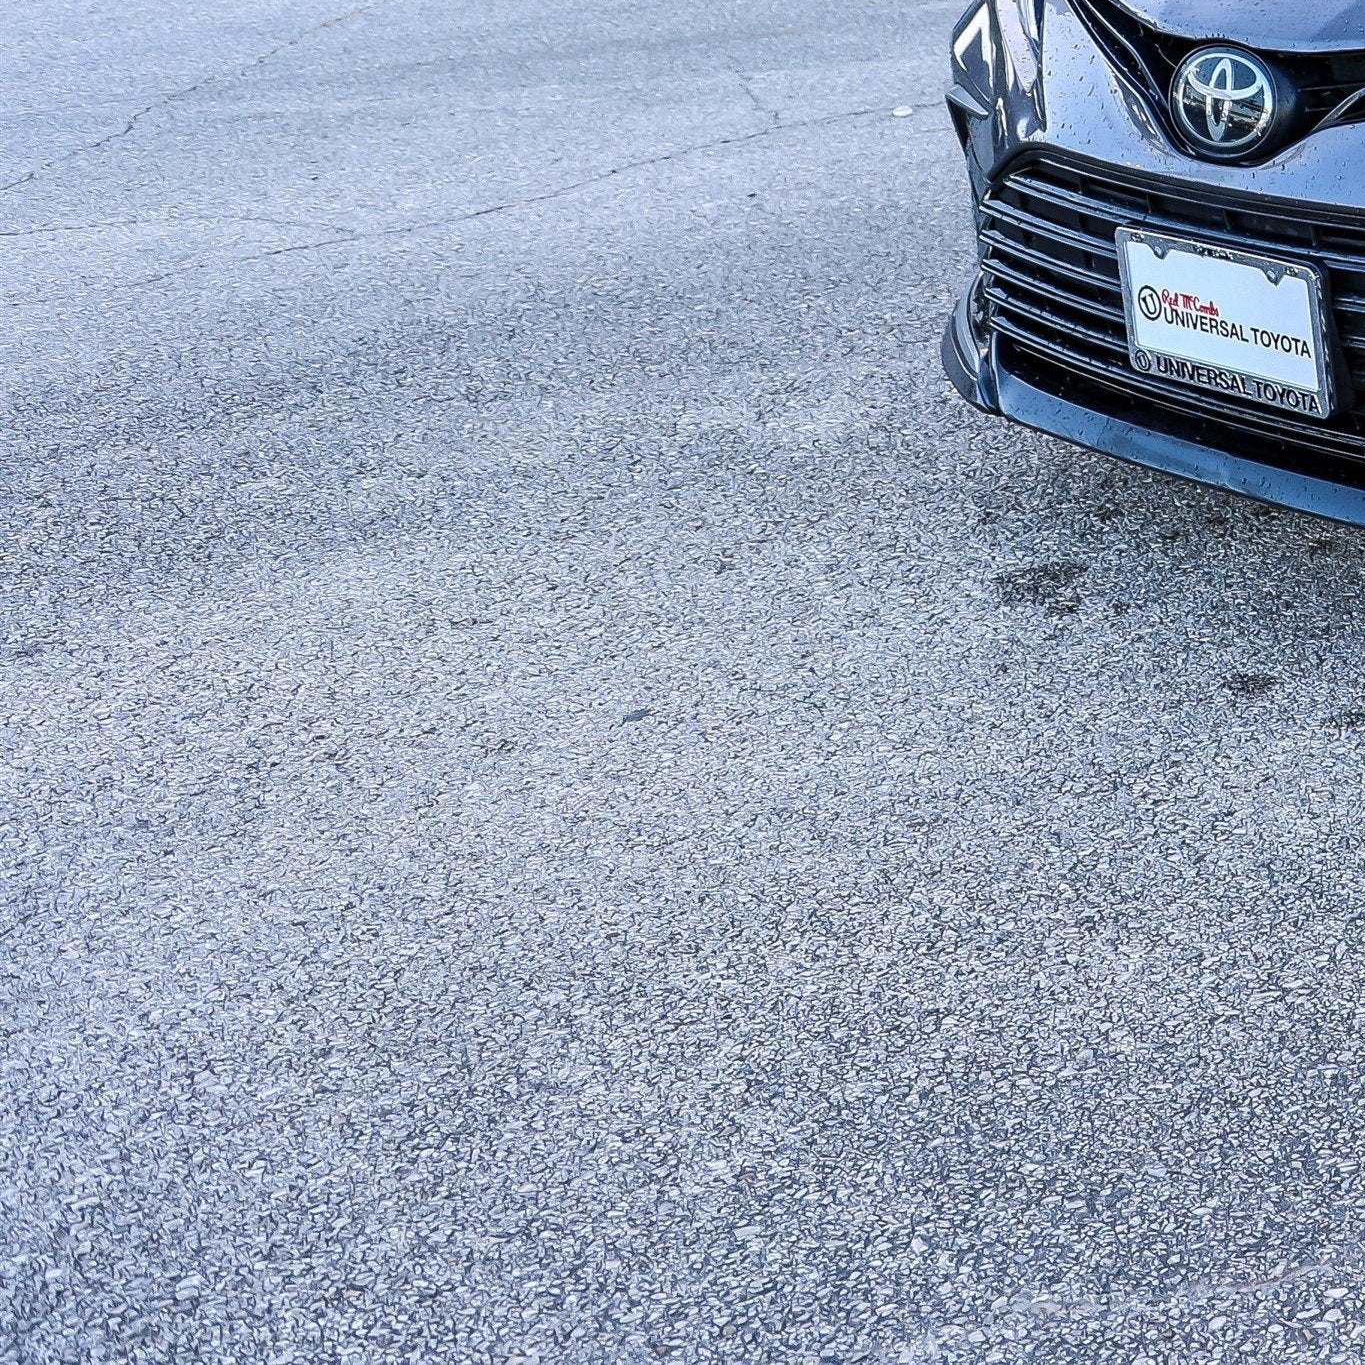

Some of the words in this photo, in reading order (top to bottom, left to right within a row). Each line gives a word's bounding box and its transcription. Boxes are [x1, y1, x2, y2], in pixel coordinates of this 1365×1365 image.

[1161, 288, 1180, 309] Red
[1163, 306, 1249, 343] UNIVERSAL
[1250, 326, 1312, 358] TOYOTA
[1156, 354, 1252, 396] UNIVERSAL
[1252, 379, 1321, 414] TOYOTA
